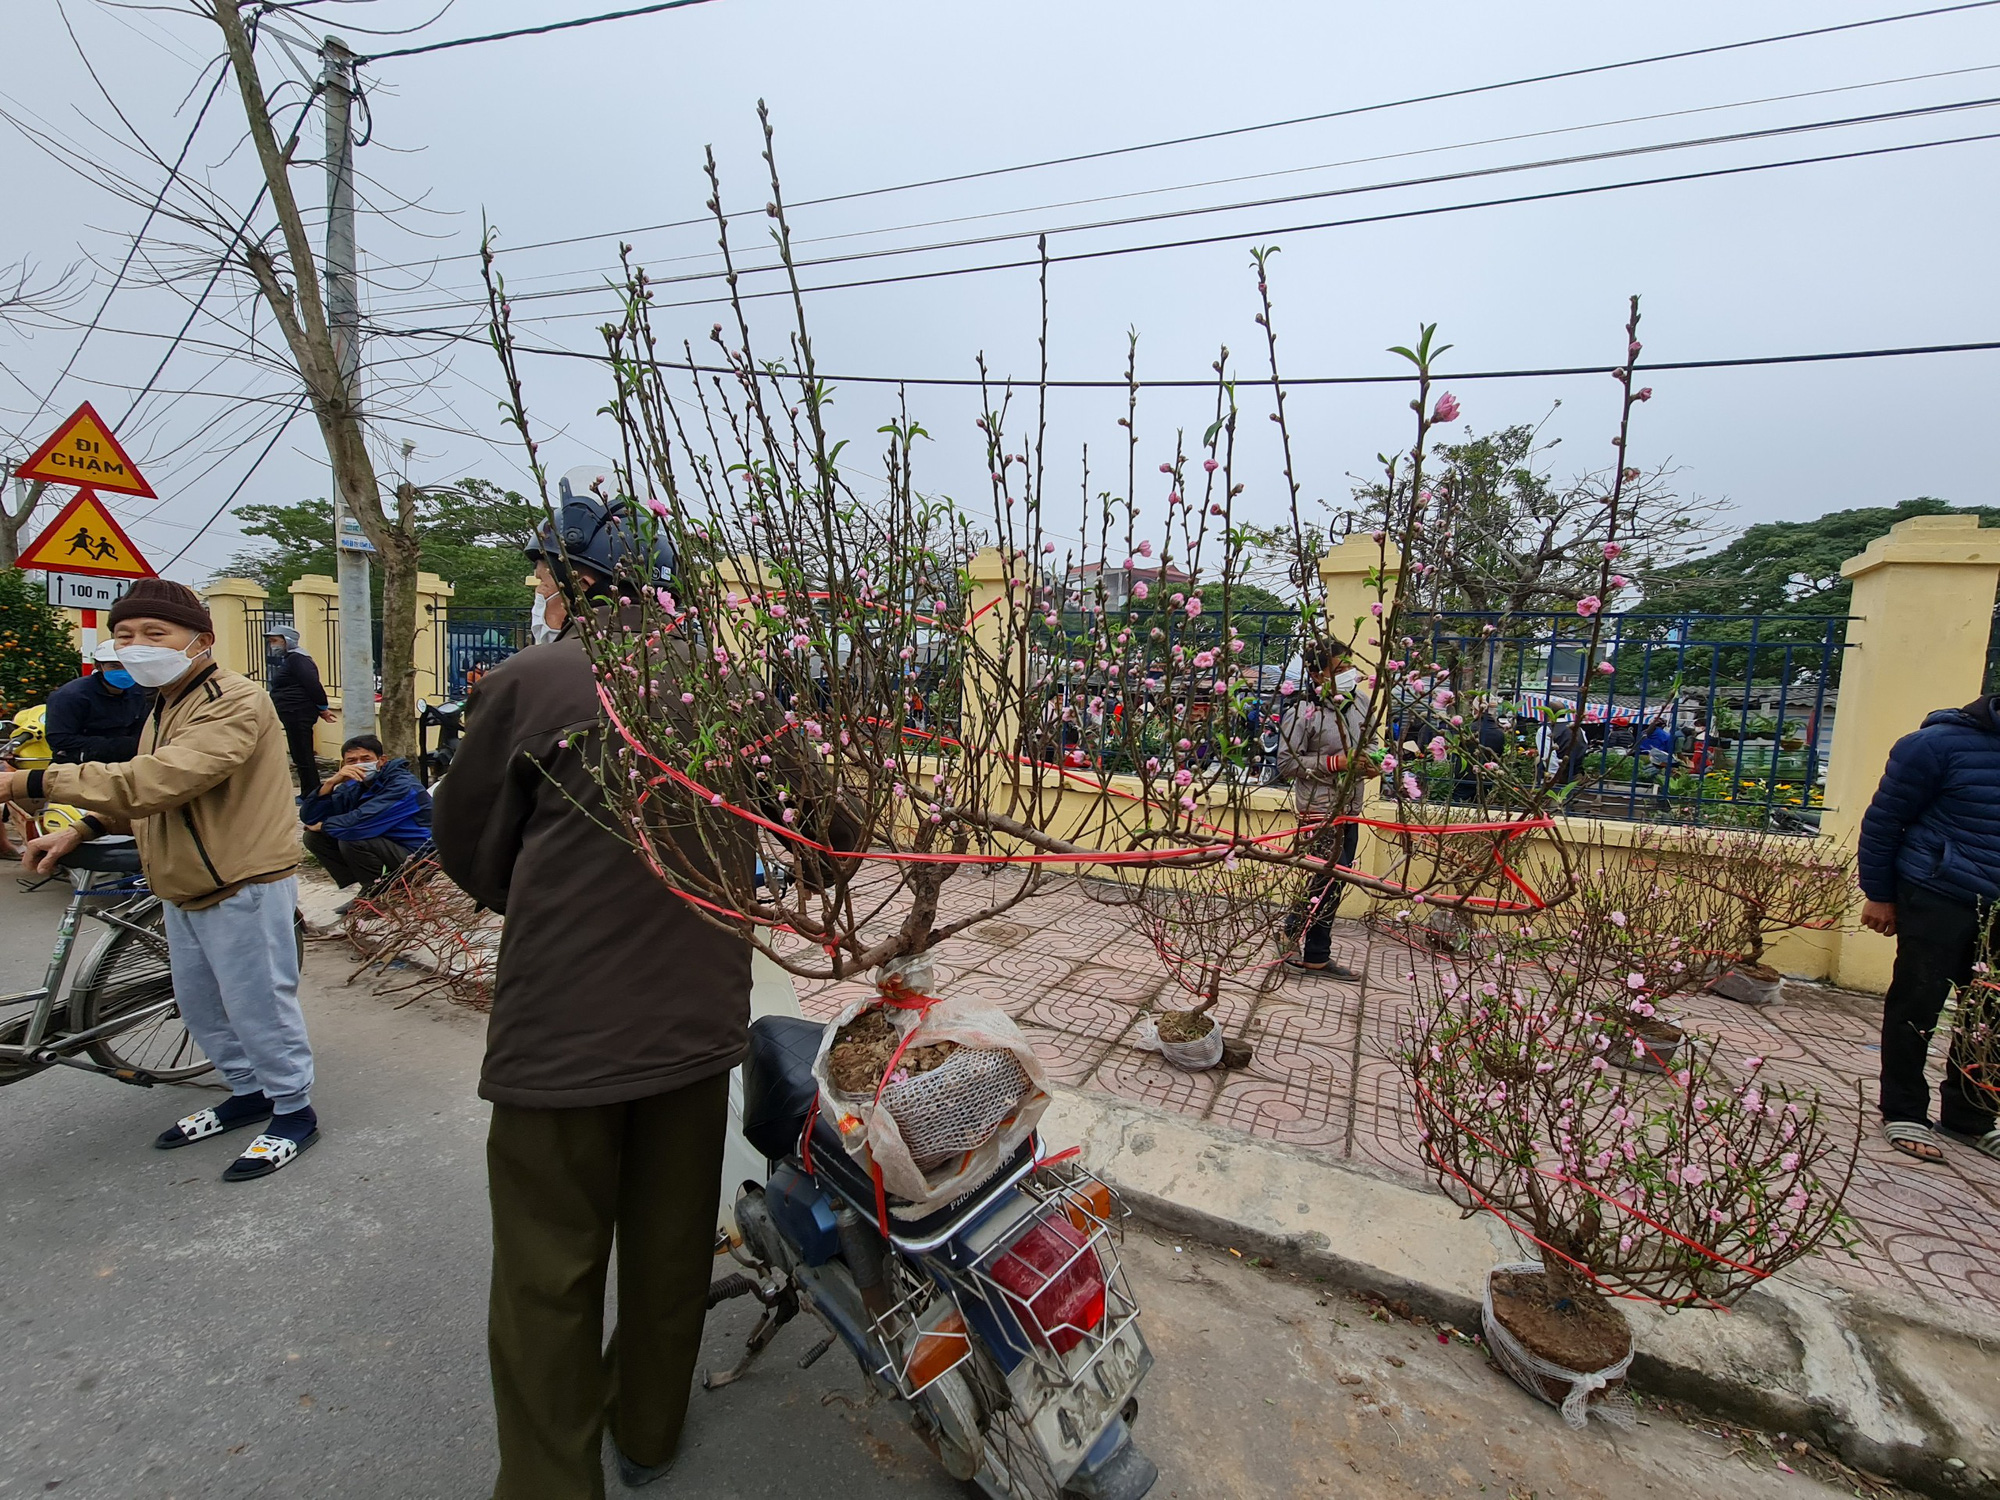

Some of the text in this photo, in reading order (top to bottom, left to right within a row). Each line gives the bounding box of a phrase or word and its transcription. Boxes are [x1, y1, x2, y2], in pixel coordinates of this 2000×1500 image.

[75, 438, 99, 454] ĐI
[51, 452, 124, 476] CHẬM
[70, 584, 109, 600] 100 m
